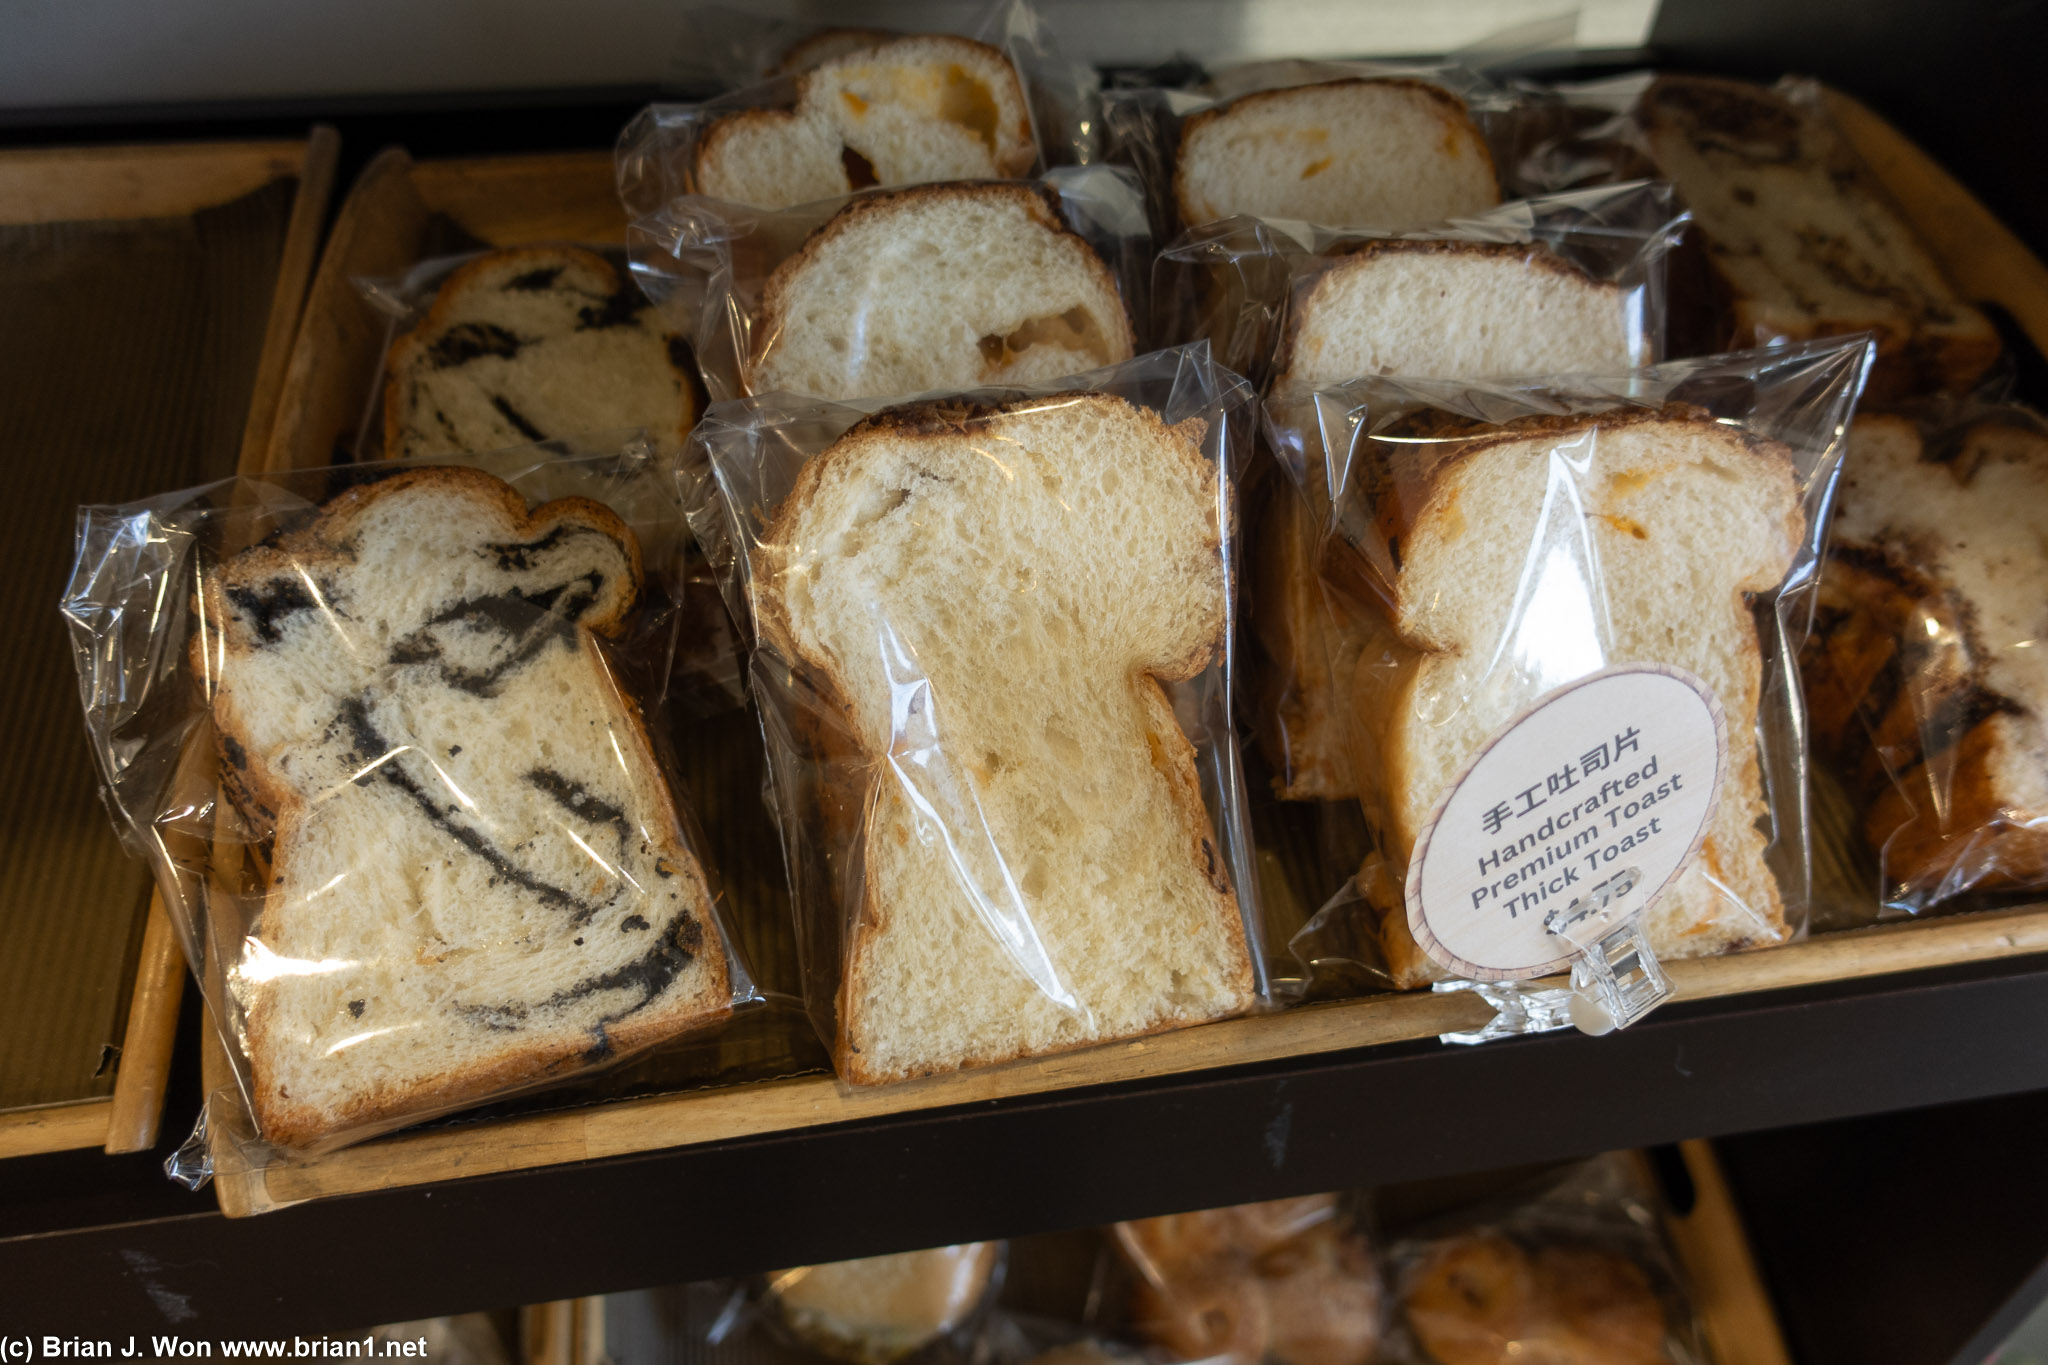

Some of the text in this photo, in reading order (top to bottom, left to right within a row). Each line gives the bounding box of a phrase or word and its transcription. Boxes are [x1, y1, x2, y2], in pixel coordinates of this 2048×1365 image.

[1478, 755, 1660, 876] Handcrafted
[1482, 726, 1640, 835] 手工吐司片
[1471, 773, 1683, 910] Premium Toast
[1503, 817, 1662, 919] Thick Toast
